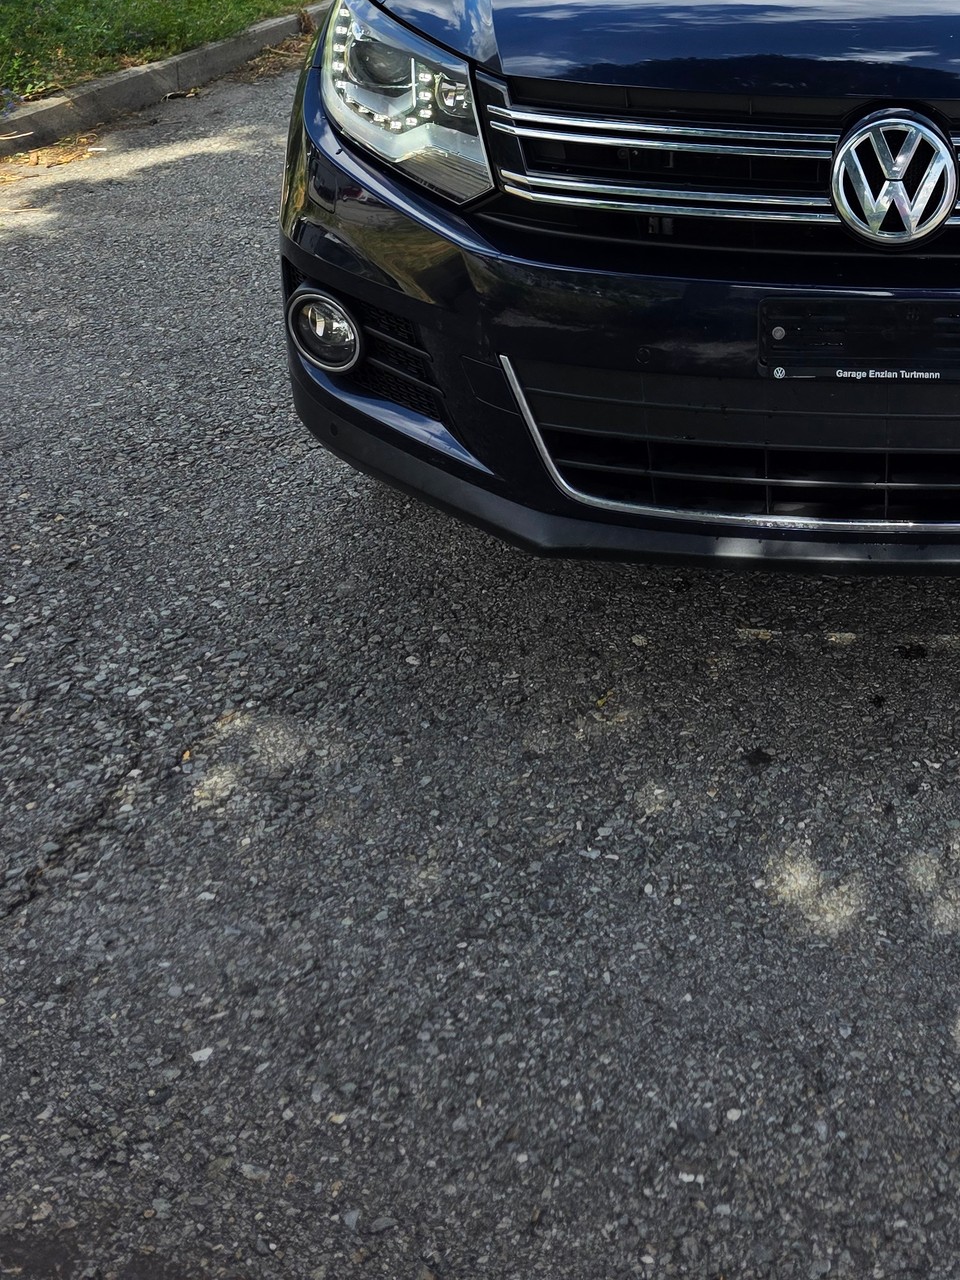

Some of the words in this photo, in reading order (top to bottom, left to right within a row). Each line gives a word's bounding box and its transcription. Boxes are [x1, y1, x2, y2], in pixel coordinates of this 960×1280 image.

[836, 369, 867, 380] Garage
[869, 370, 898, 378] Enzian
[900, 370, 941, 379] Turtmann
